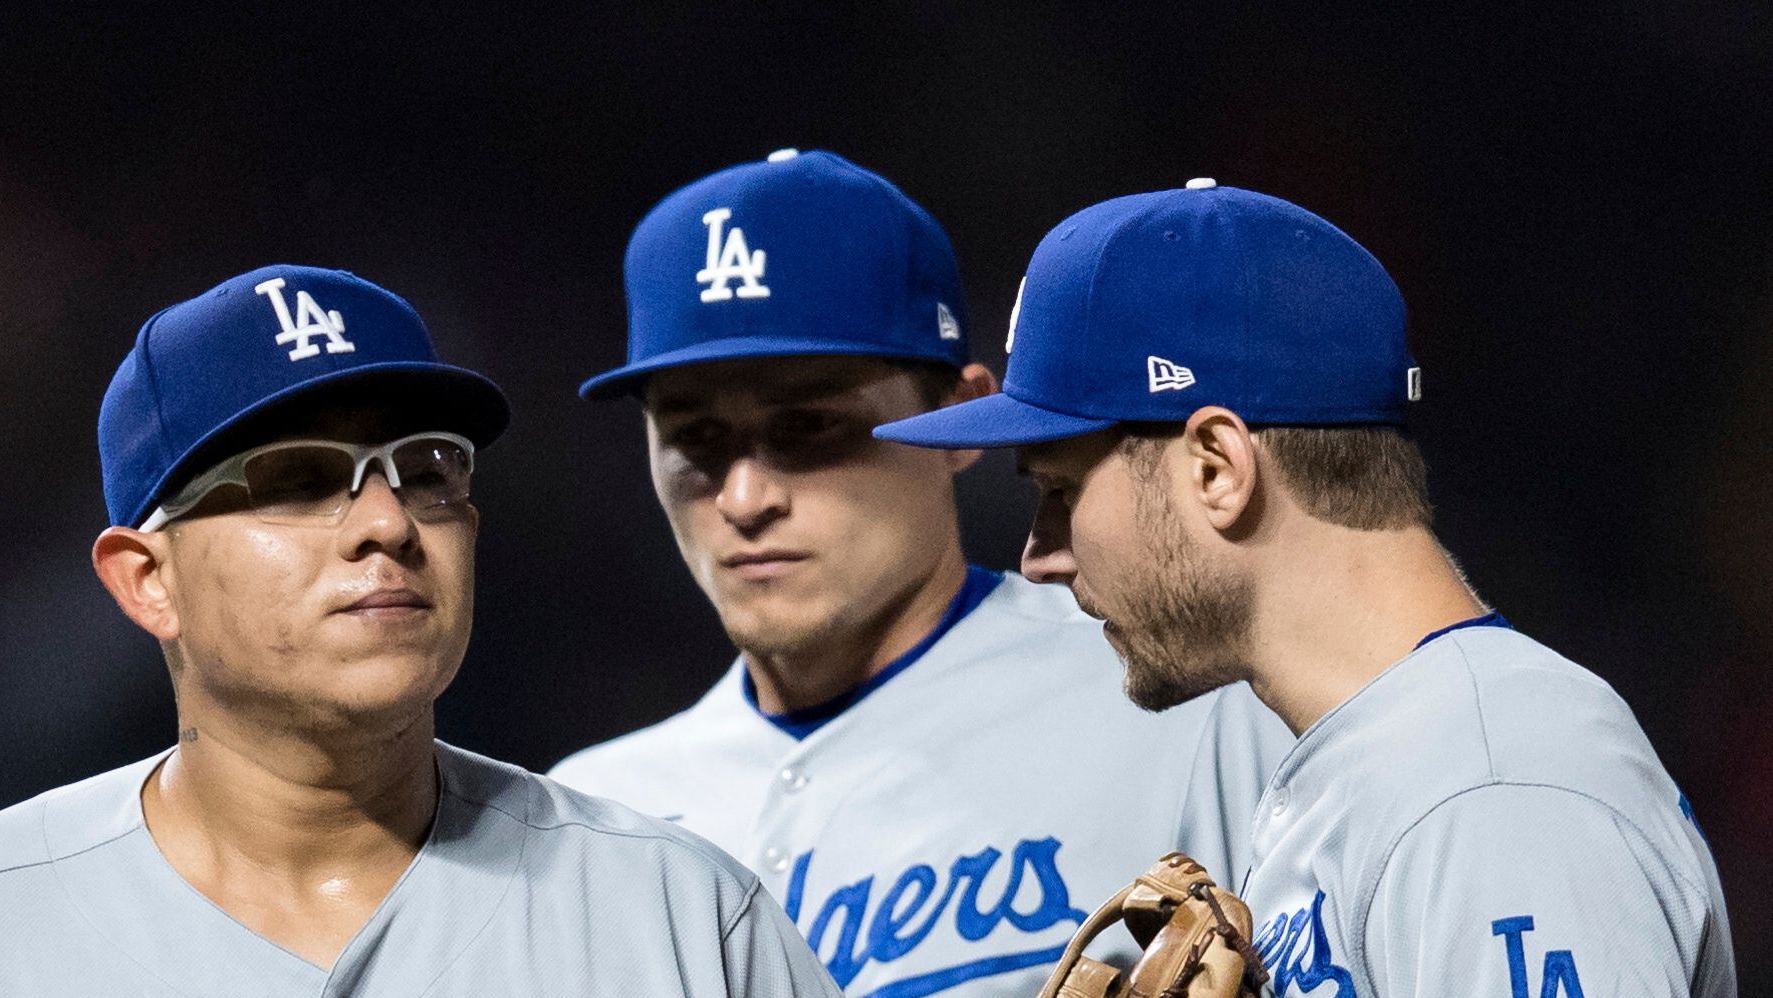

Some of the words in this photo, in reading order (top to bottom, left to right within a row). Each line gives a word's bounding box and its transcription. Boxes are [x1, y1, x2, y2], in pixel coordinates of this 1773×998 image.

[695, 207, 771, 303] LA
[254, 277, 356, 361] LA
[785, 835, 1091, 992] gers
